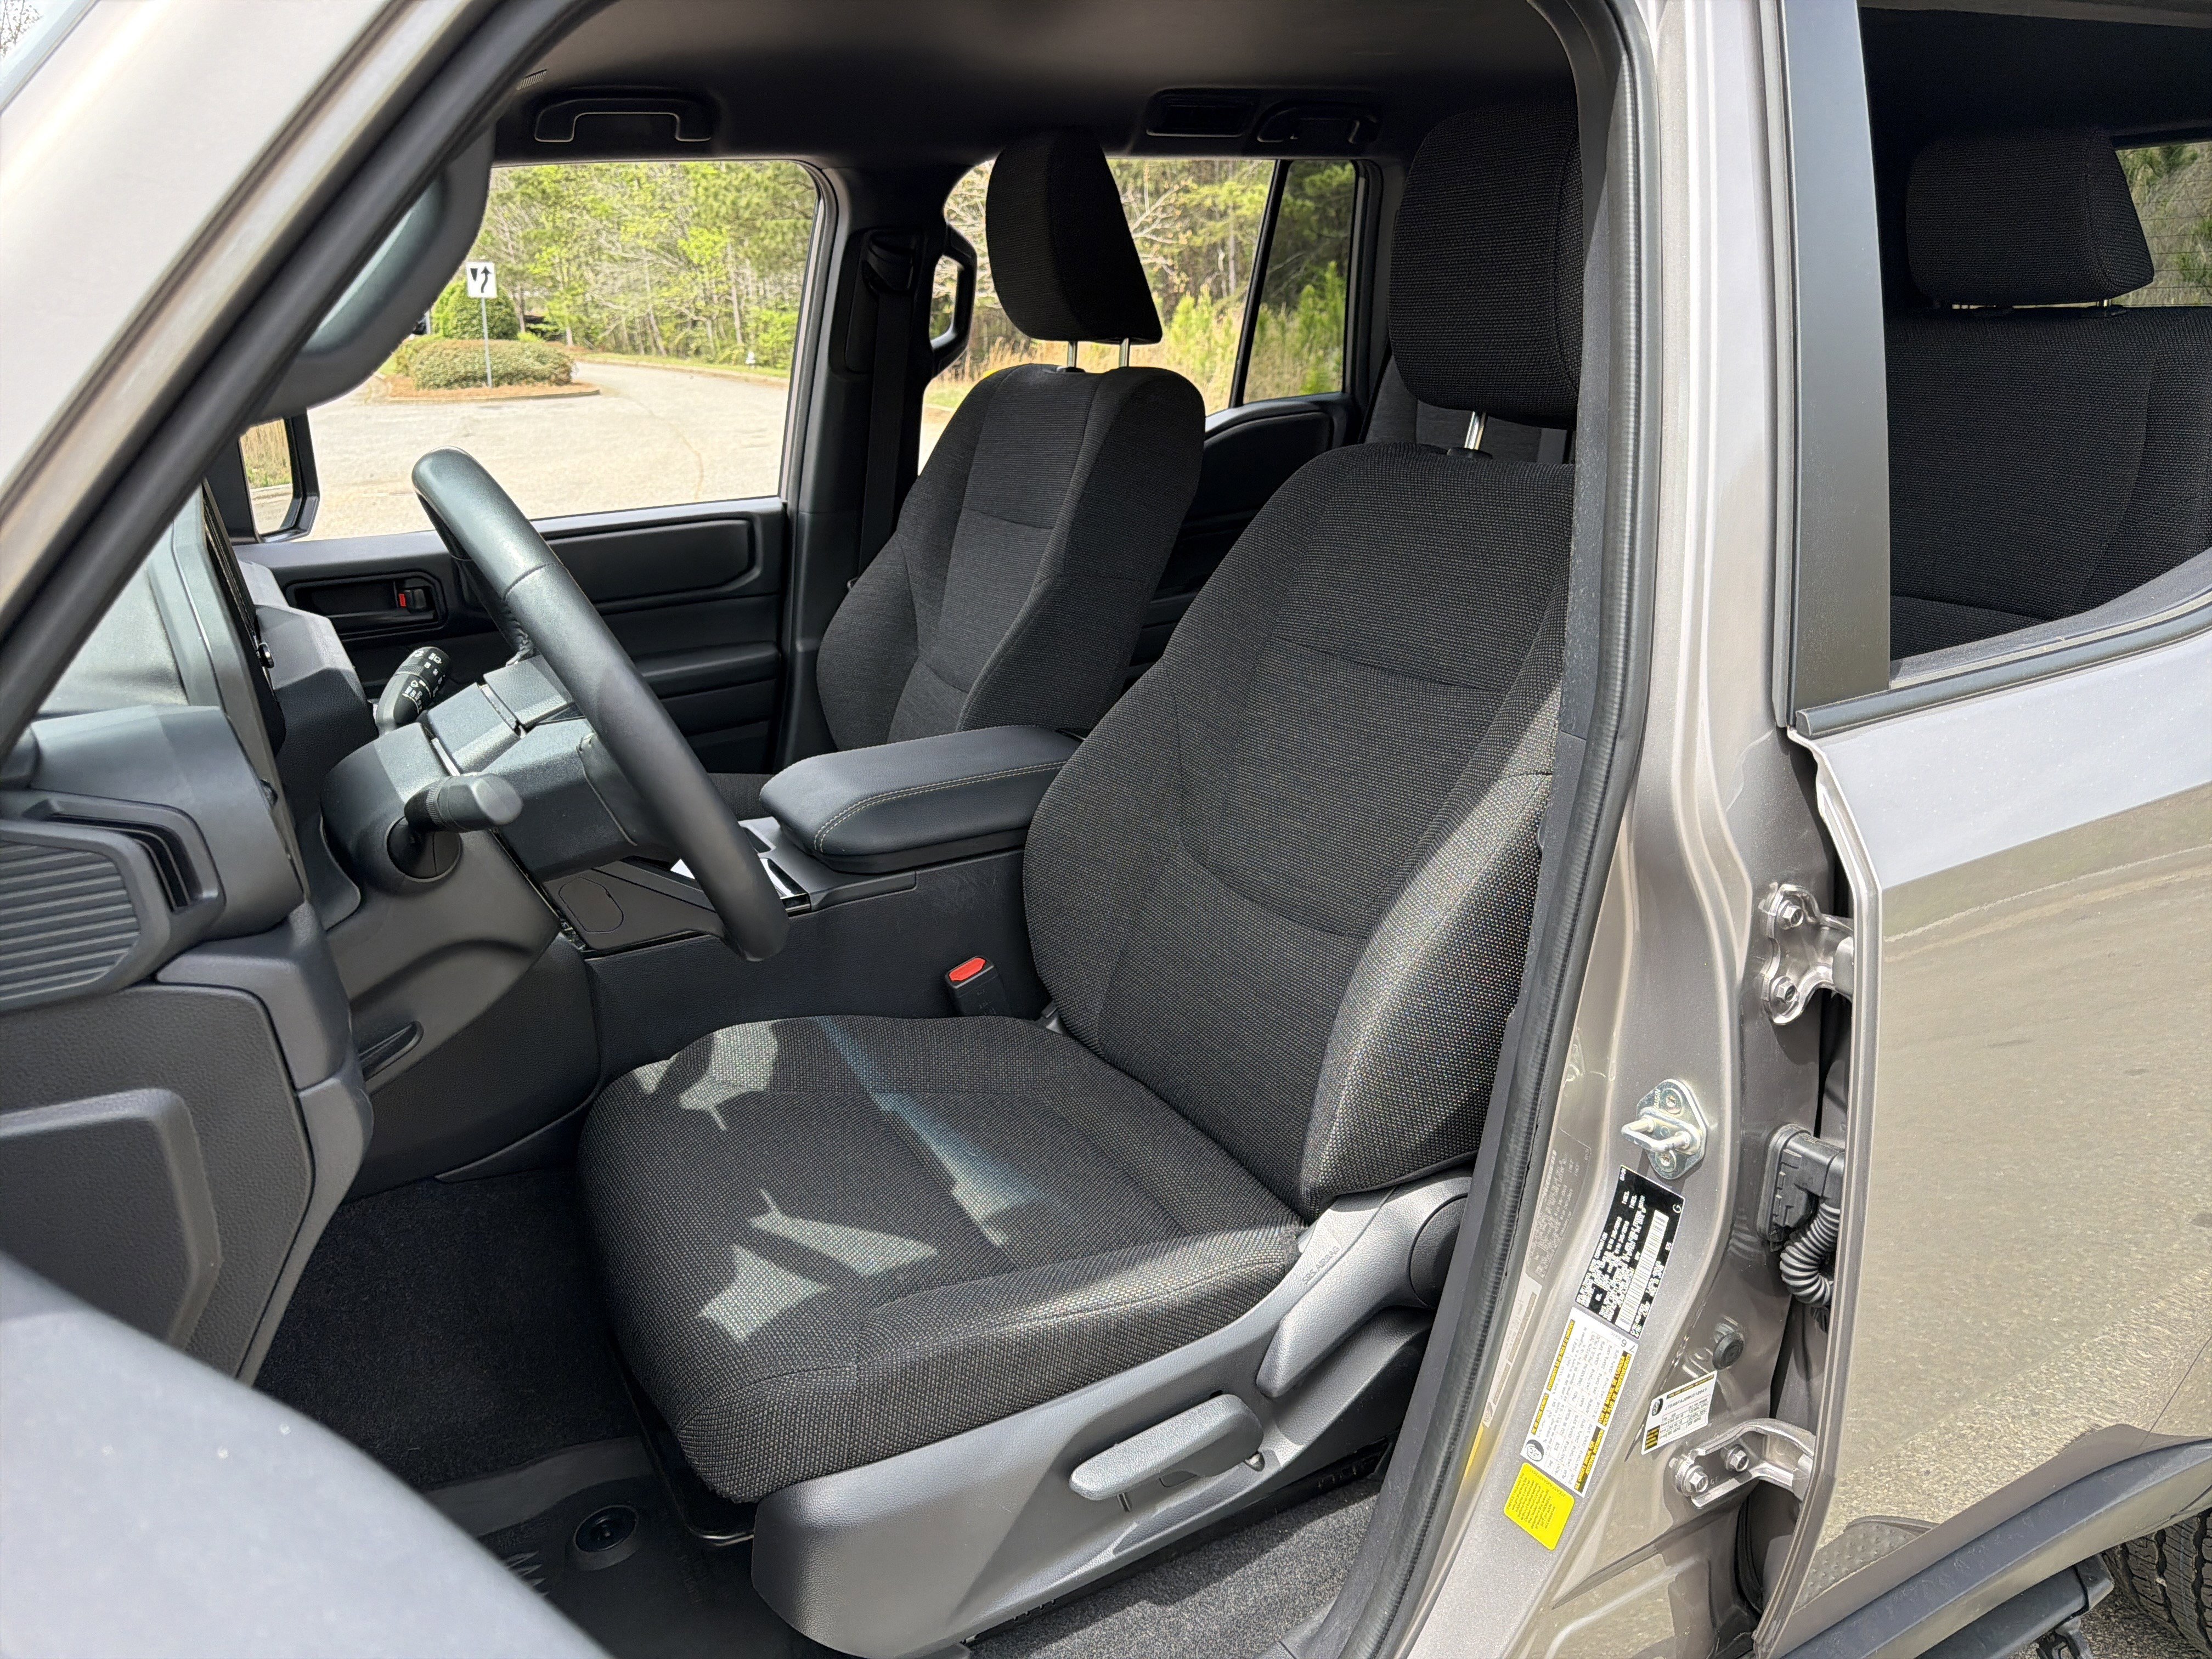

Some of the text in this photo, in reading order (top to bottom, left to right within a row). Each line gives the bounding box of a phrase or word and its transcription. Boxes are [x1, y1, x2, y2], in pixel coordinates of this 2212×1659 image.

[1672, 1203, 1681, 1213] G
[1302, 1246, 1340, 1284] SRS AIRBAG
